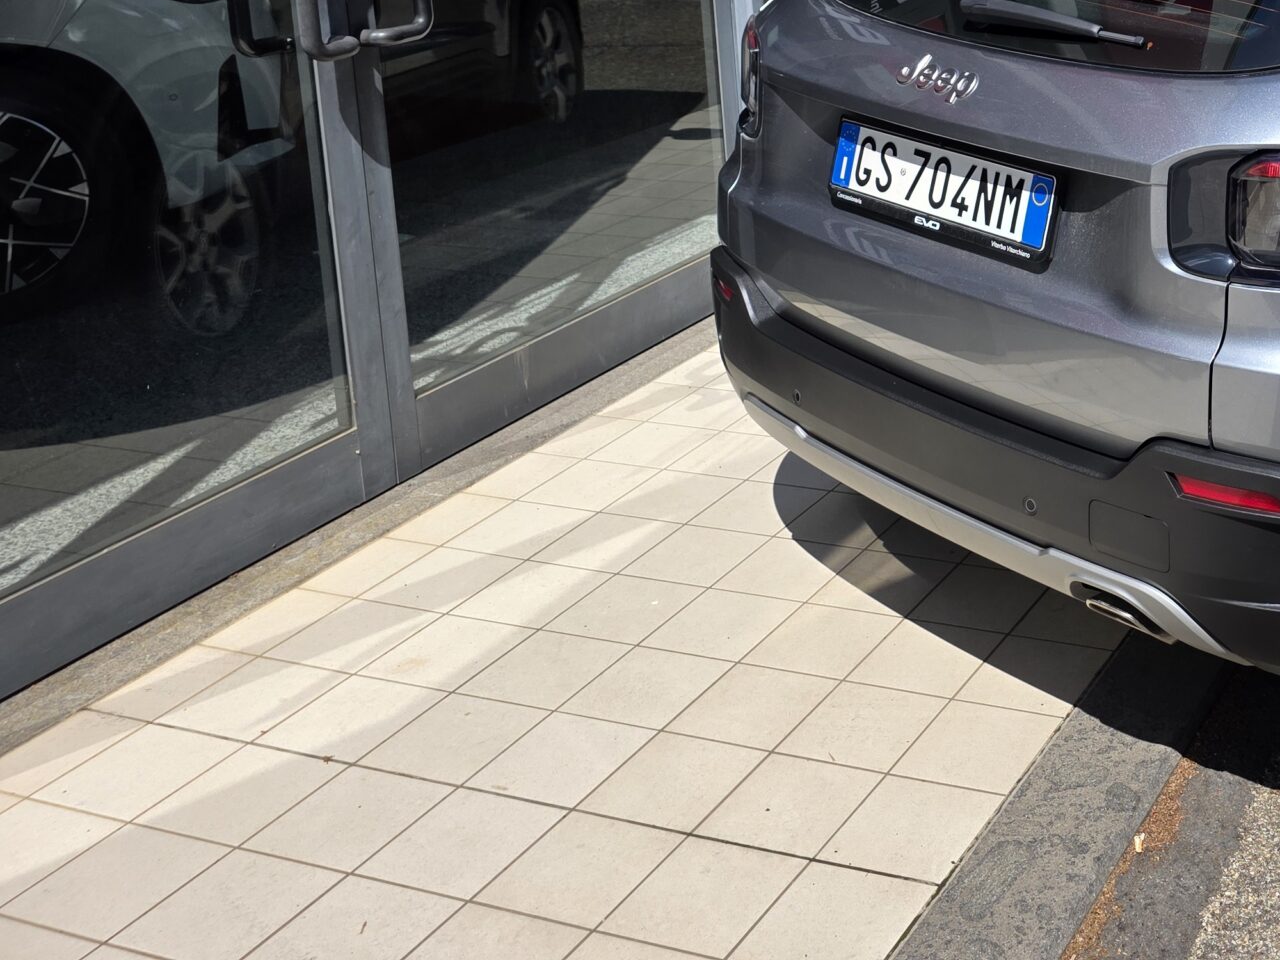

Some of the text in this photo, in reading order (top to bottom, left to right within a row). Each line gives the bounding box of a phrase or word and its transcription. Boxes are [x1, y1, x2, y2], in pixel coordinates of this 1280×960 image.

[896, 53, 979, 105] Jeep
[855, 135, 1026, 235] GS 704NM
[914, 215, 941, 231] EVO
